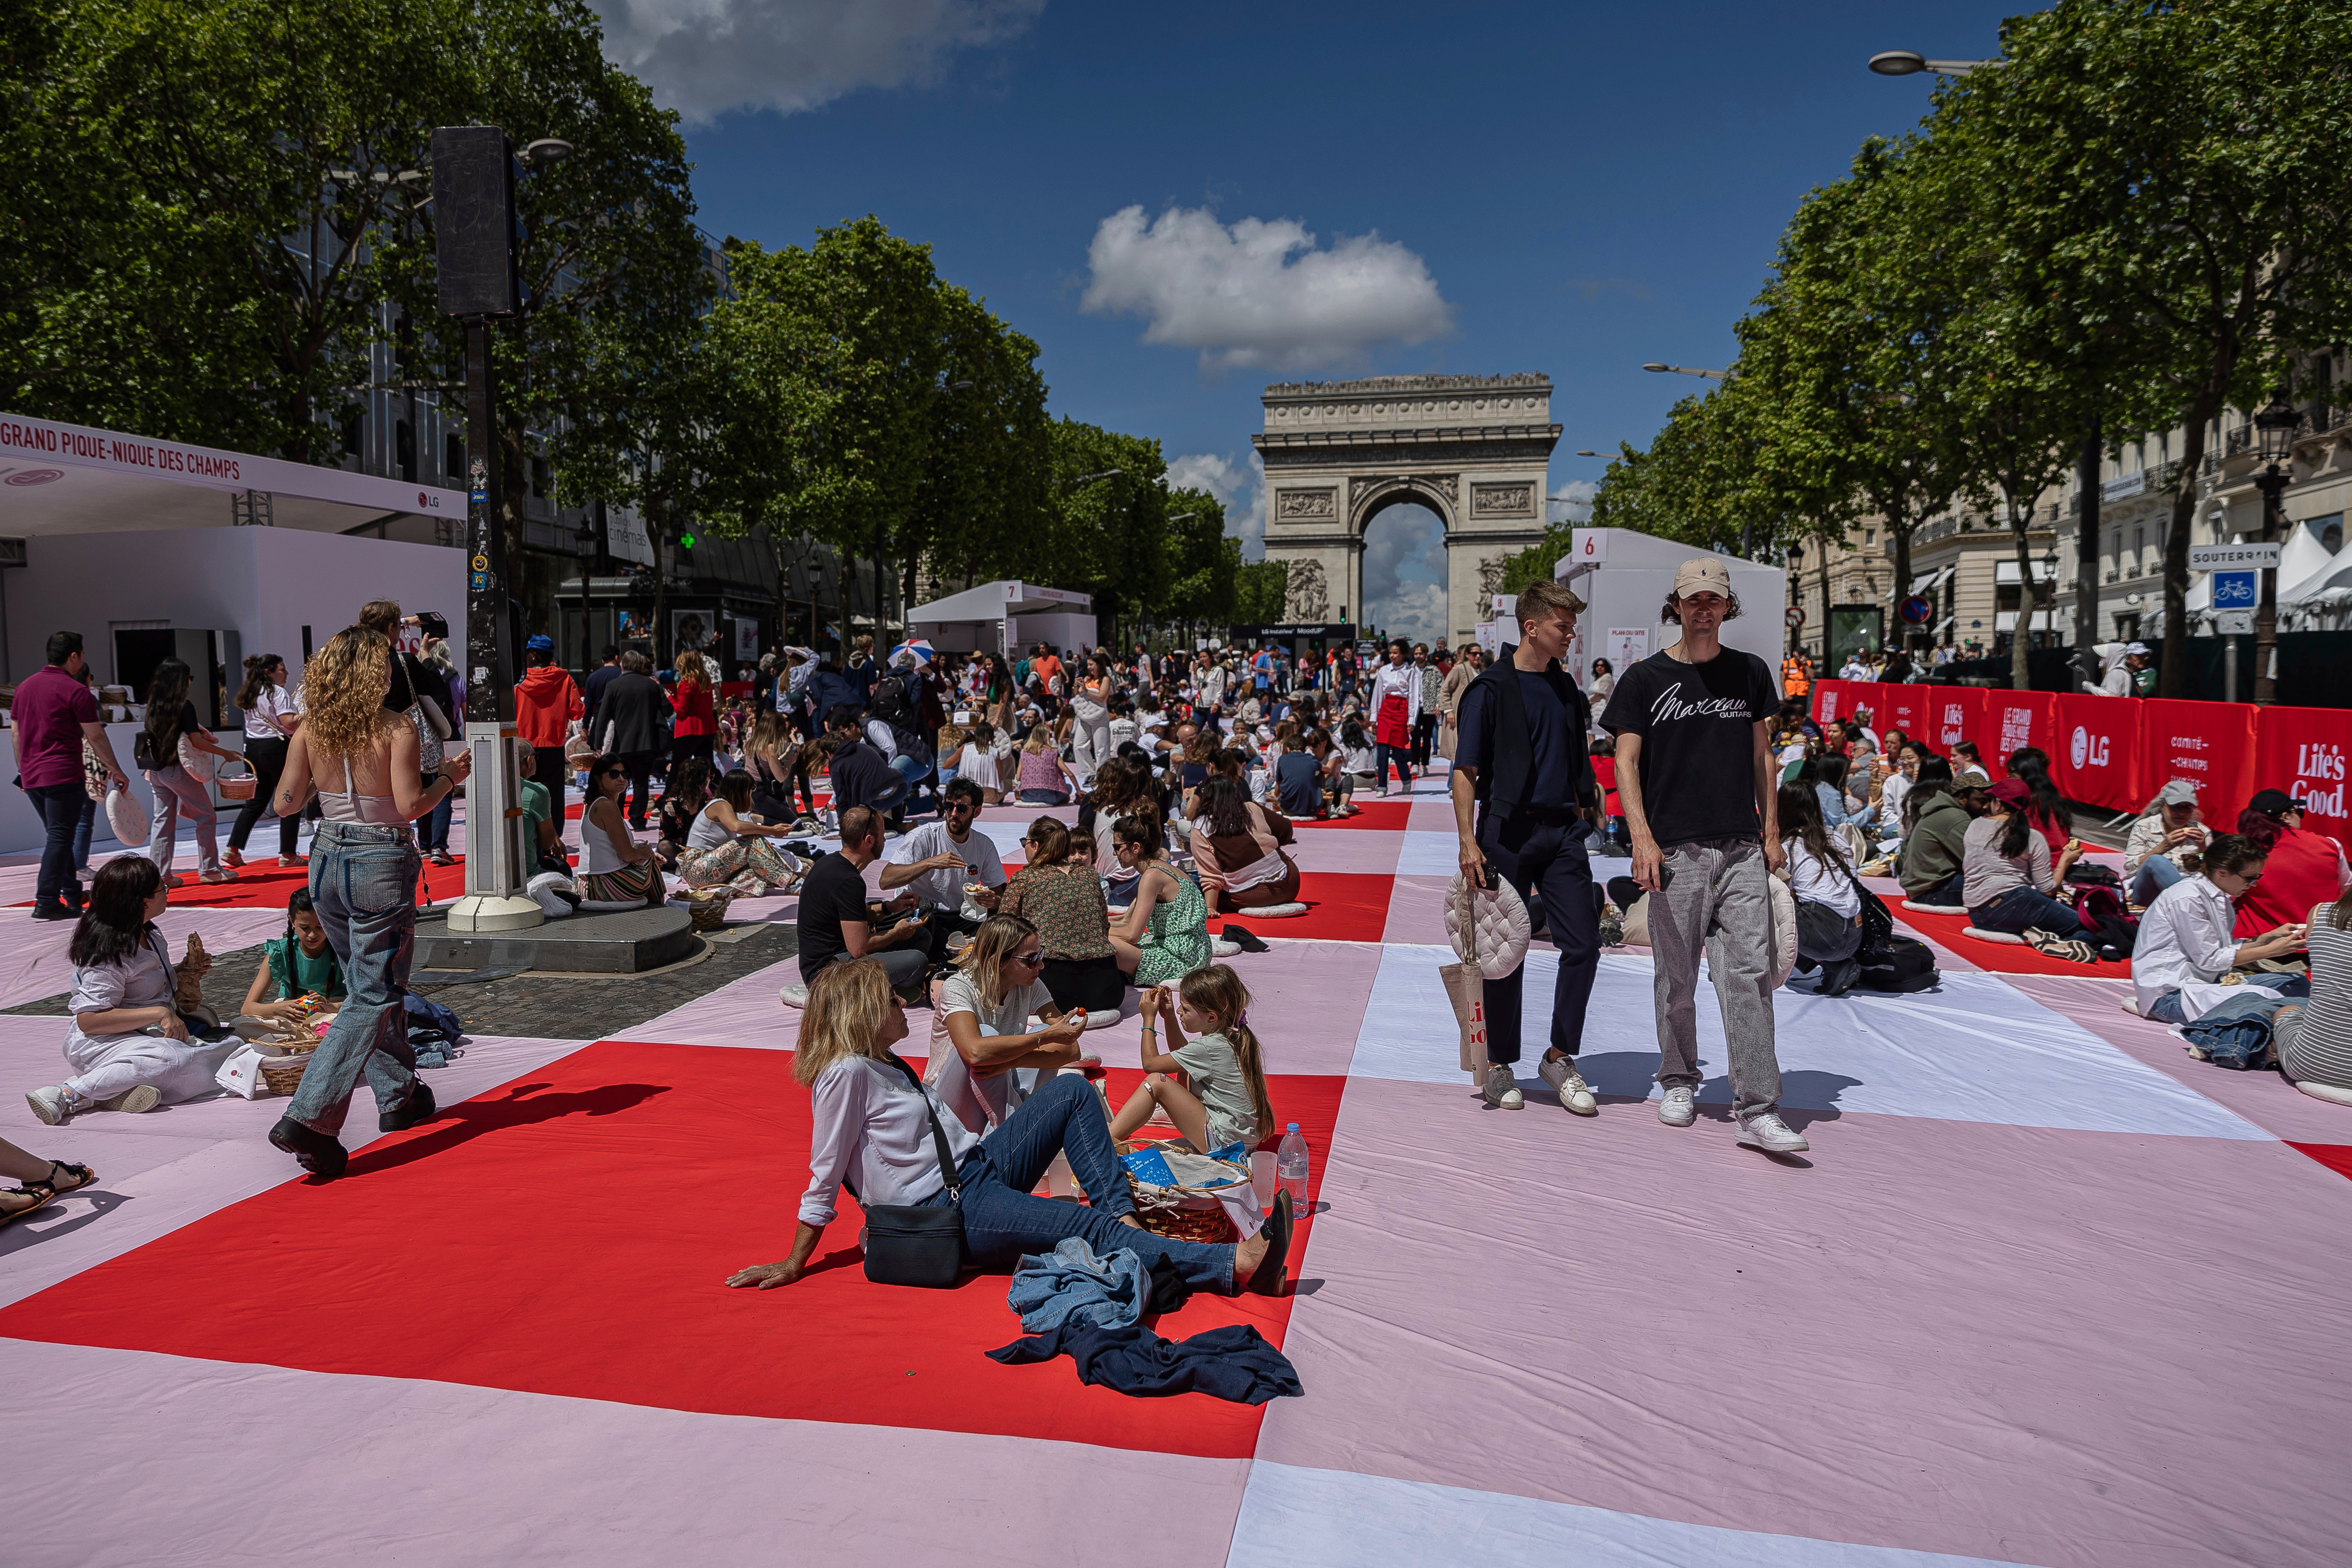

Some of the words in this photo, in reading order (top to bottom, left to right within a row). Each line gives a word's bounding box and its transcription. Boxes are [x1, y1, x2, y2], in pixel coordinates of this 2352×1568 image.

[1, 423, 57, 452] GRAND
[62, 432, 155, 468] PIQUE-NIQUE
[158, 448, 184, 471] DES
[187, 453, 240, 480] CHAMPS
[428, 495, 439, 508] LG
[609, 525, 646, 547] cinémas
[1585, 536, 1594, 555] 6
[1008, 585, 1015, 598] 7
[1650, 682, 1746, 726] Marceau
[1944, 704, 1963, 726] Life's
[2003, 707, 2012, 723] LE
[2012, 707, 2032, 726] GRAND
[2088, 735, 2111, 767] LG
[2296, 743, 2346, 780] Life's
[2290, 780, 2349, 819] Good.
